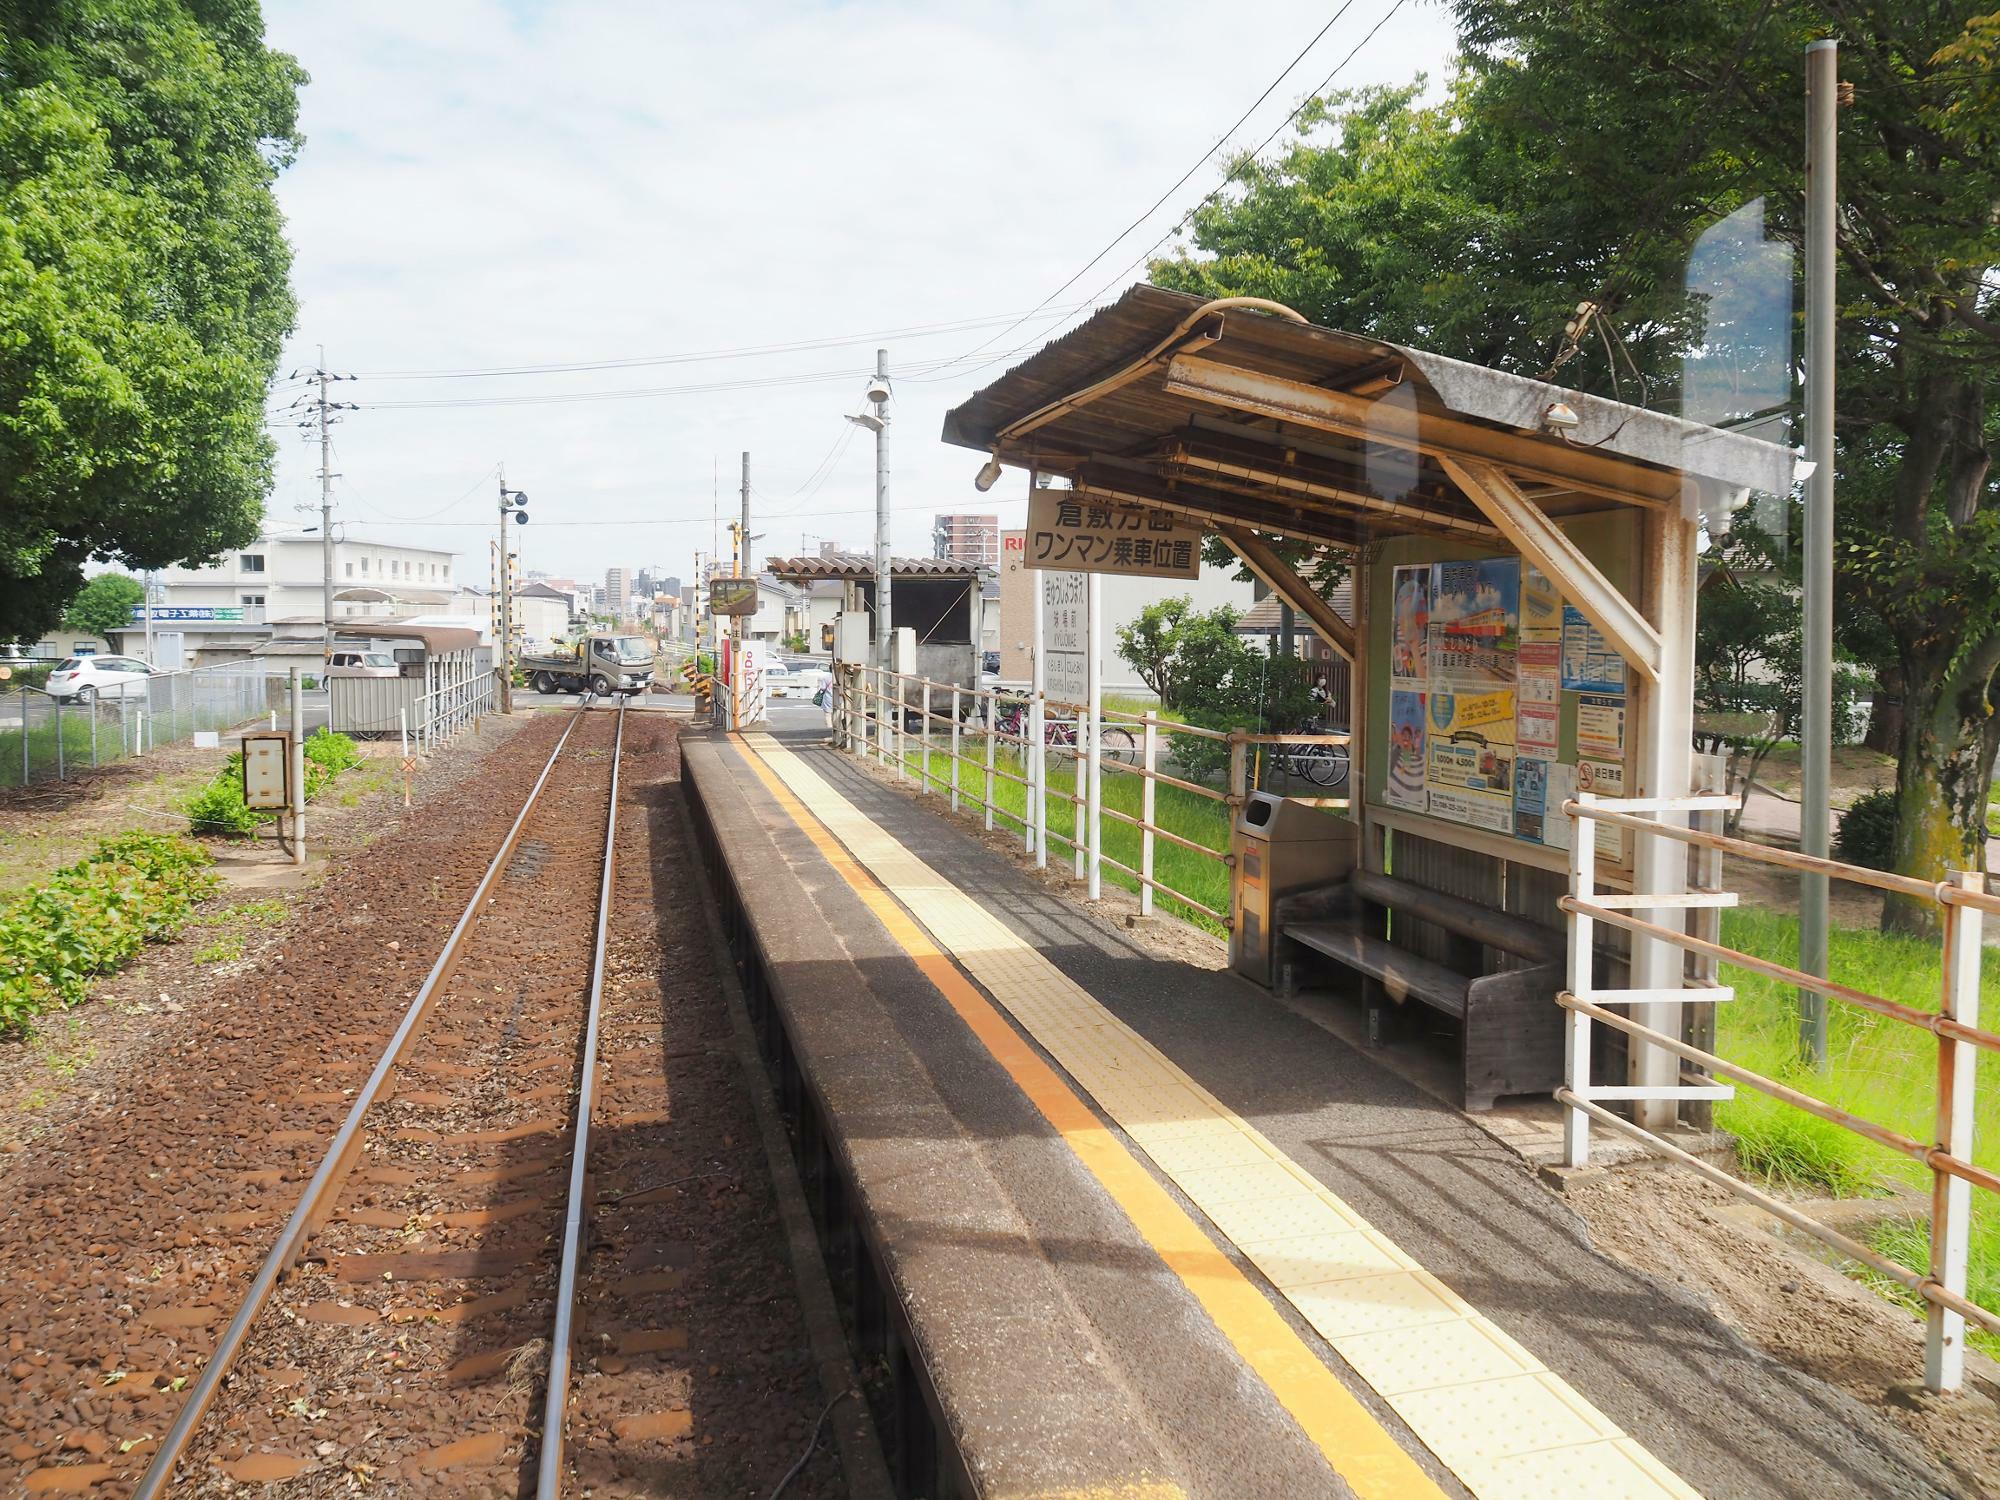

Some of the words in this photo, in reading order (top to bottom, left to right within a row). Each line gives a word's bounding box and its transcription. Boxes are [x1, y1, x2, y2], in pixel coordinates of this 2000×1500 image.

[1005, 537, 1027, 551] RI
[1035, 531, 1192, 569] ワンマン乗車位置
[1045, 574, 1084, 606] きゅうじょうまえ
